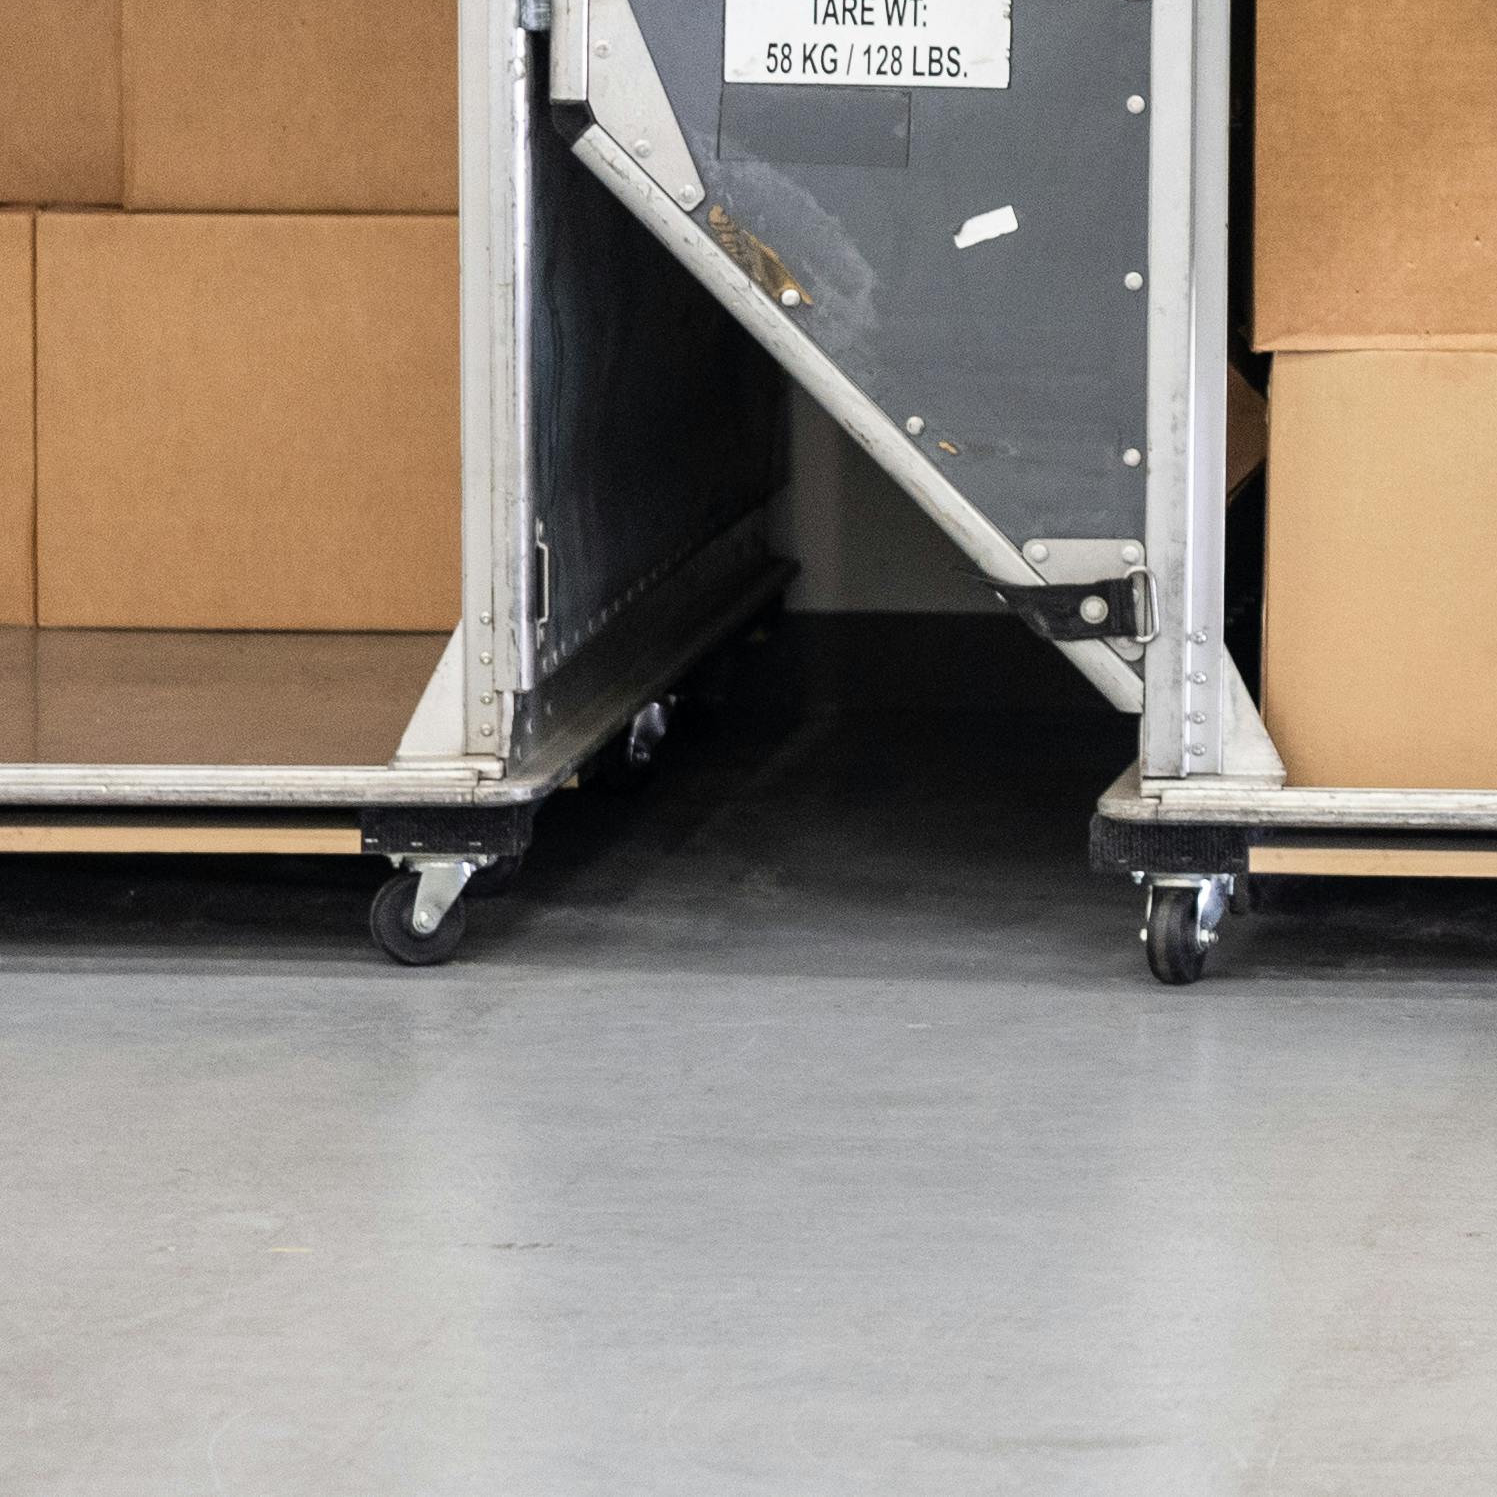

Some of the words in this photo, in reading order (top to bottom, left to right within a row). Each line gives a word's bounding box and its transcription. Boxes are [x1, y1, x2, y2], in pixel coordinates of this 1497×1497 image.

[766, 43, 792, 74] 58
[802, 44, 838, 75] KG
[847, 44, 854, 76] /
[862, 45, 903, 76] 128
[912, 46, 968, 78] LBS.
